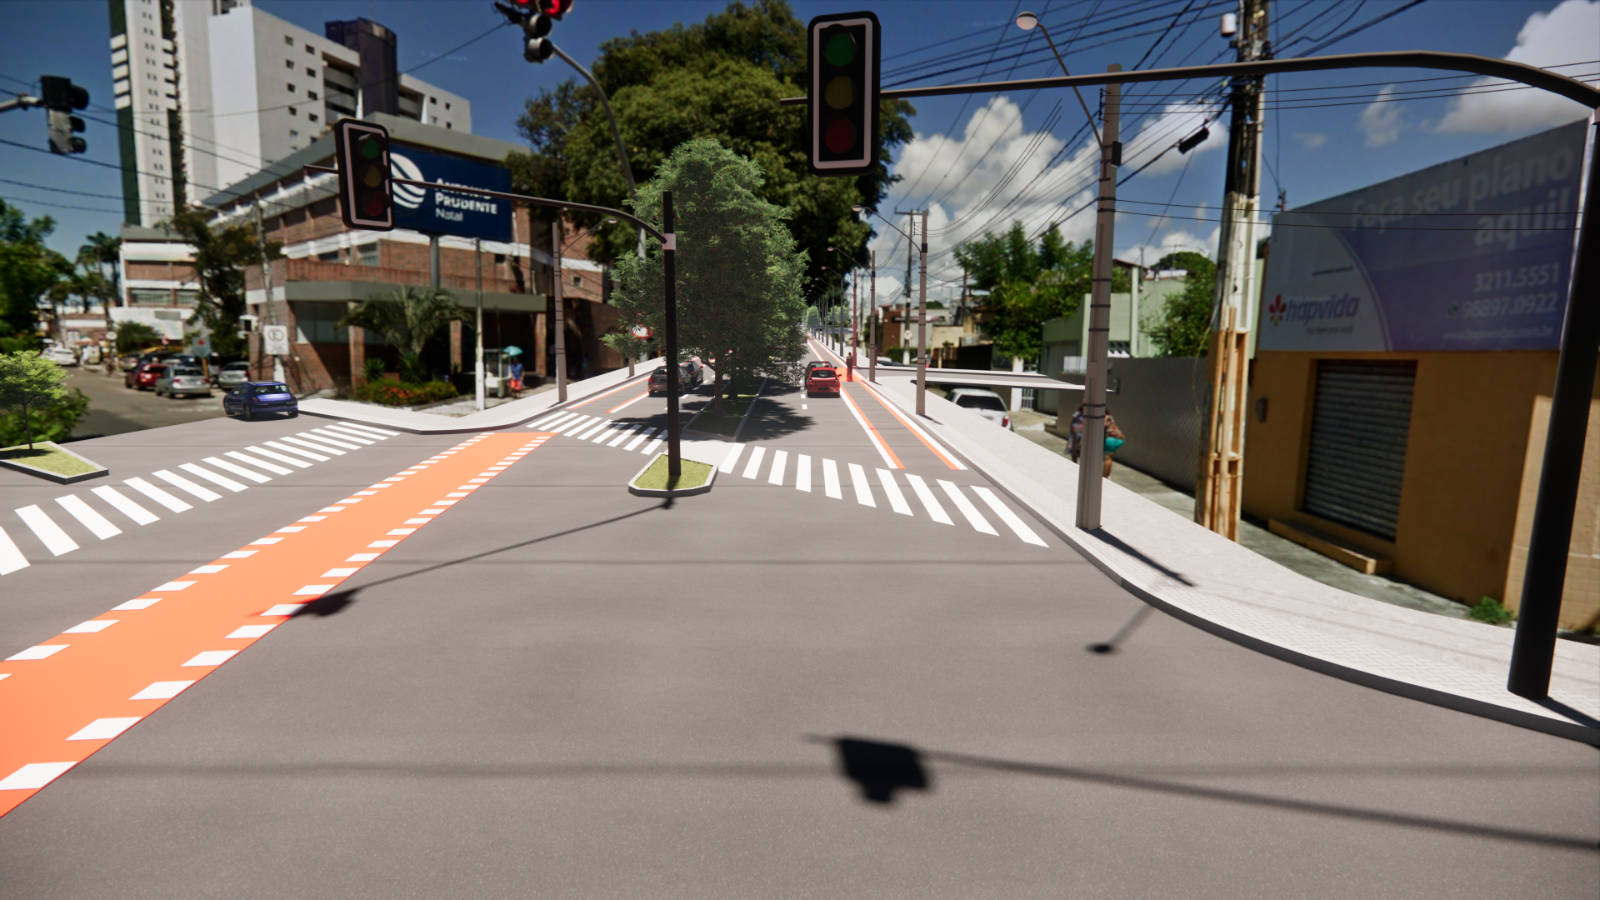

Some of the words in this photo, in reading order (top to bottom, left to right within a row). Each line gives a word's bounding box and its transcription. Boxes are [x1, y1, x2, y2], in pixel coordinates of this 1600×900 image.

[434, 192, 498, 215] PRUDENTE
[1350, 195, 1404, 234] Faça
[1411, 179, 1460, 217] seu
[1467, 147, 1574, 212] plano
[434, 207, 464, 222] Natal
[1474, 187, 1570, 250] aqui!
[1474, 262, 1560, 292] 3211.5551
[1286, 292, 1361, 326] hapvida
